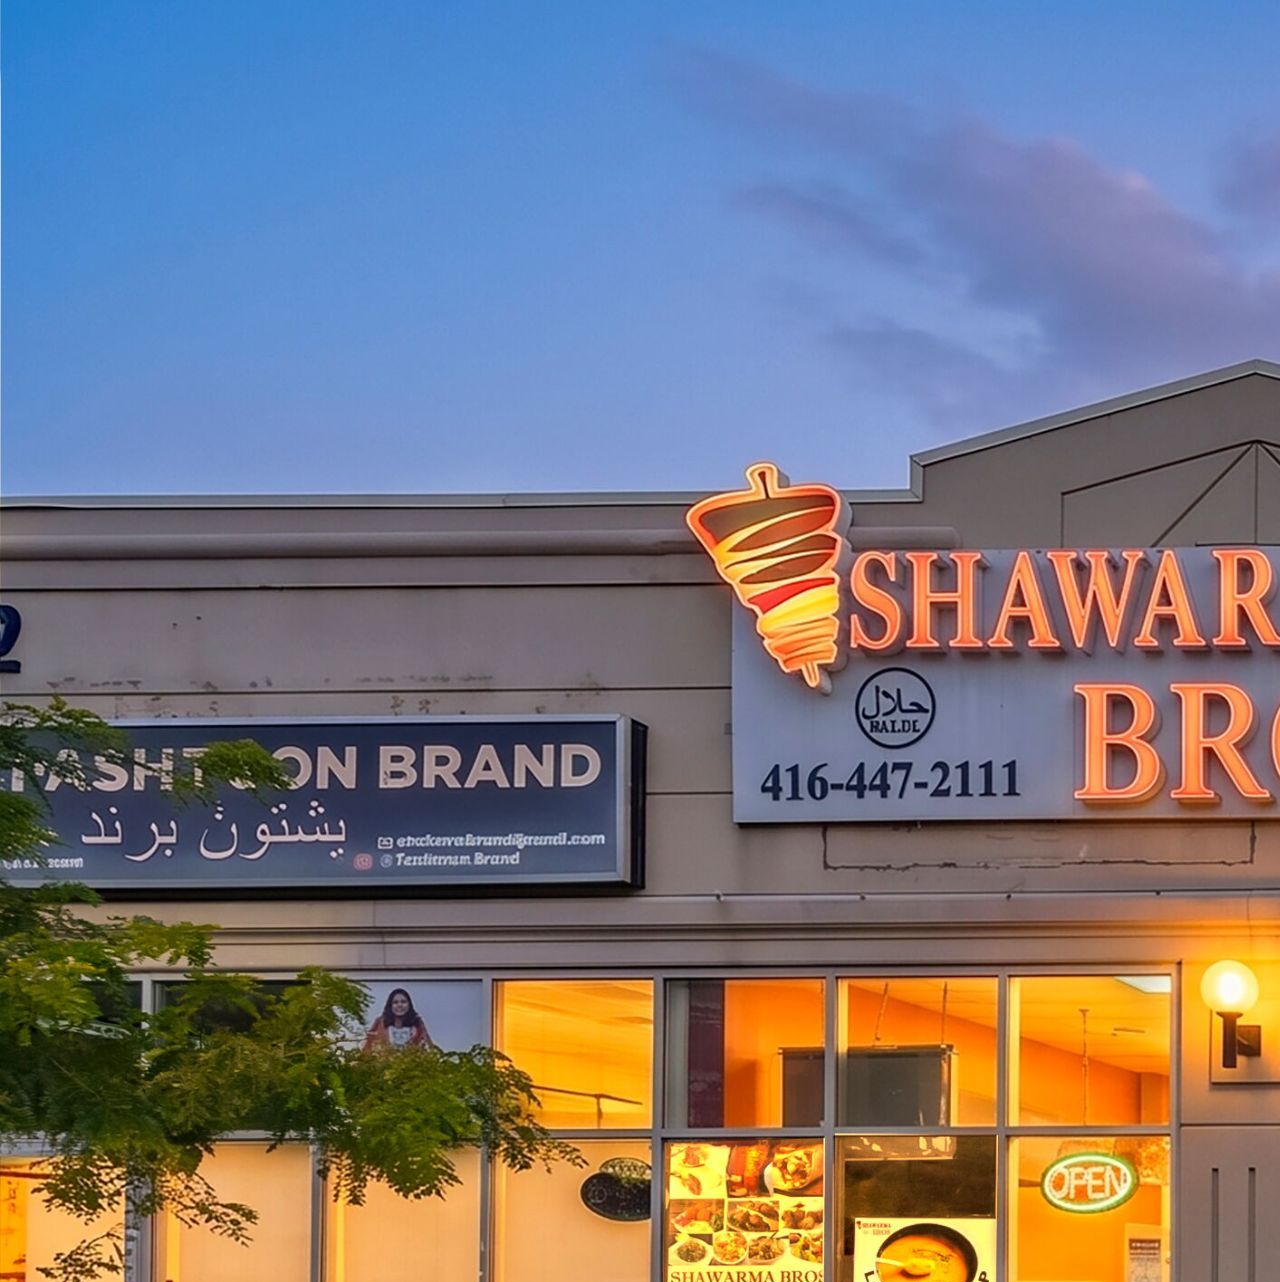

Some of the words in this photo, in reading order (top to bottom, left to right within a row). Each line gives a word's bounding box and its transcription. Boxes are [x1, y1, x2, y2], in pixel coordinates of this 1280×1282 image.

[861, 685, 930, 720] حلال
[378, 742, 602, 790] BRAND
[760, 759, 1021, 801] 416-447-2111
[1049, 1165, 1125, 1199] OPEN
